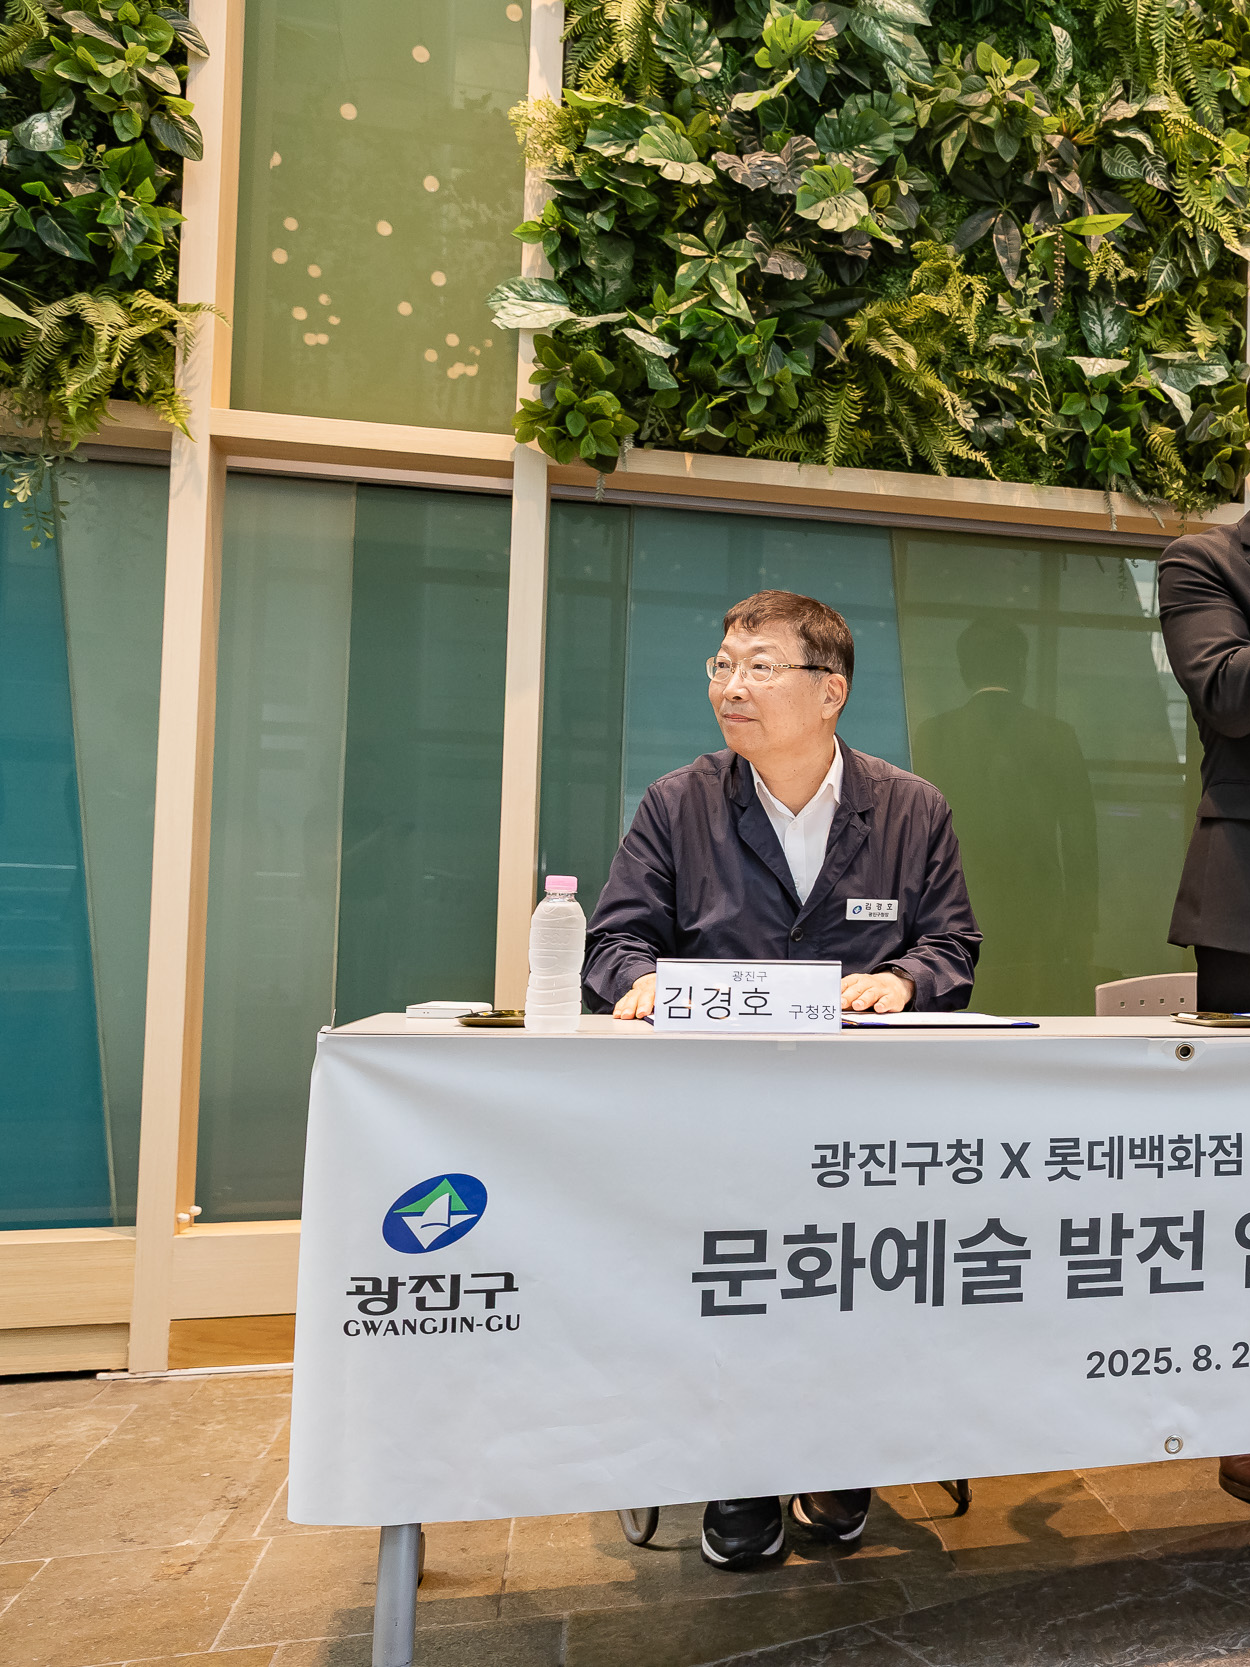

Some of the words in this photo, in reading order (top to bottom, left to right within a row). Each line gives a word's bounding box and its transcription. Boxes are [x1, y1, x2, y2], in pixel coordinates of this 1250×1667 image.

[732, 970, 768, 982] 광진구
[662, 985, 773, 1020] 김경호
[788, 1004, 837, 1020] 구청장
[811, 1138, 985, 1188] 광진구청
[1000, 1141, 1032, 1180] X
[1043, 1132, 1244, 1182] 롯데백화점
[691, 1217, 1032, 1318] 문화예술
[1059, 1209, 1205, 1300] 발전
[346, 1272, 519, 1316] 광진구
[342, 1313, 521, 1337] GWANGJIN-GU
[1086, 1347, 1182, 1379] 2025.
[1192, 1343, 1222, 1372] 8.
